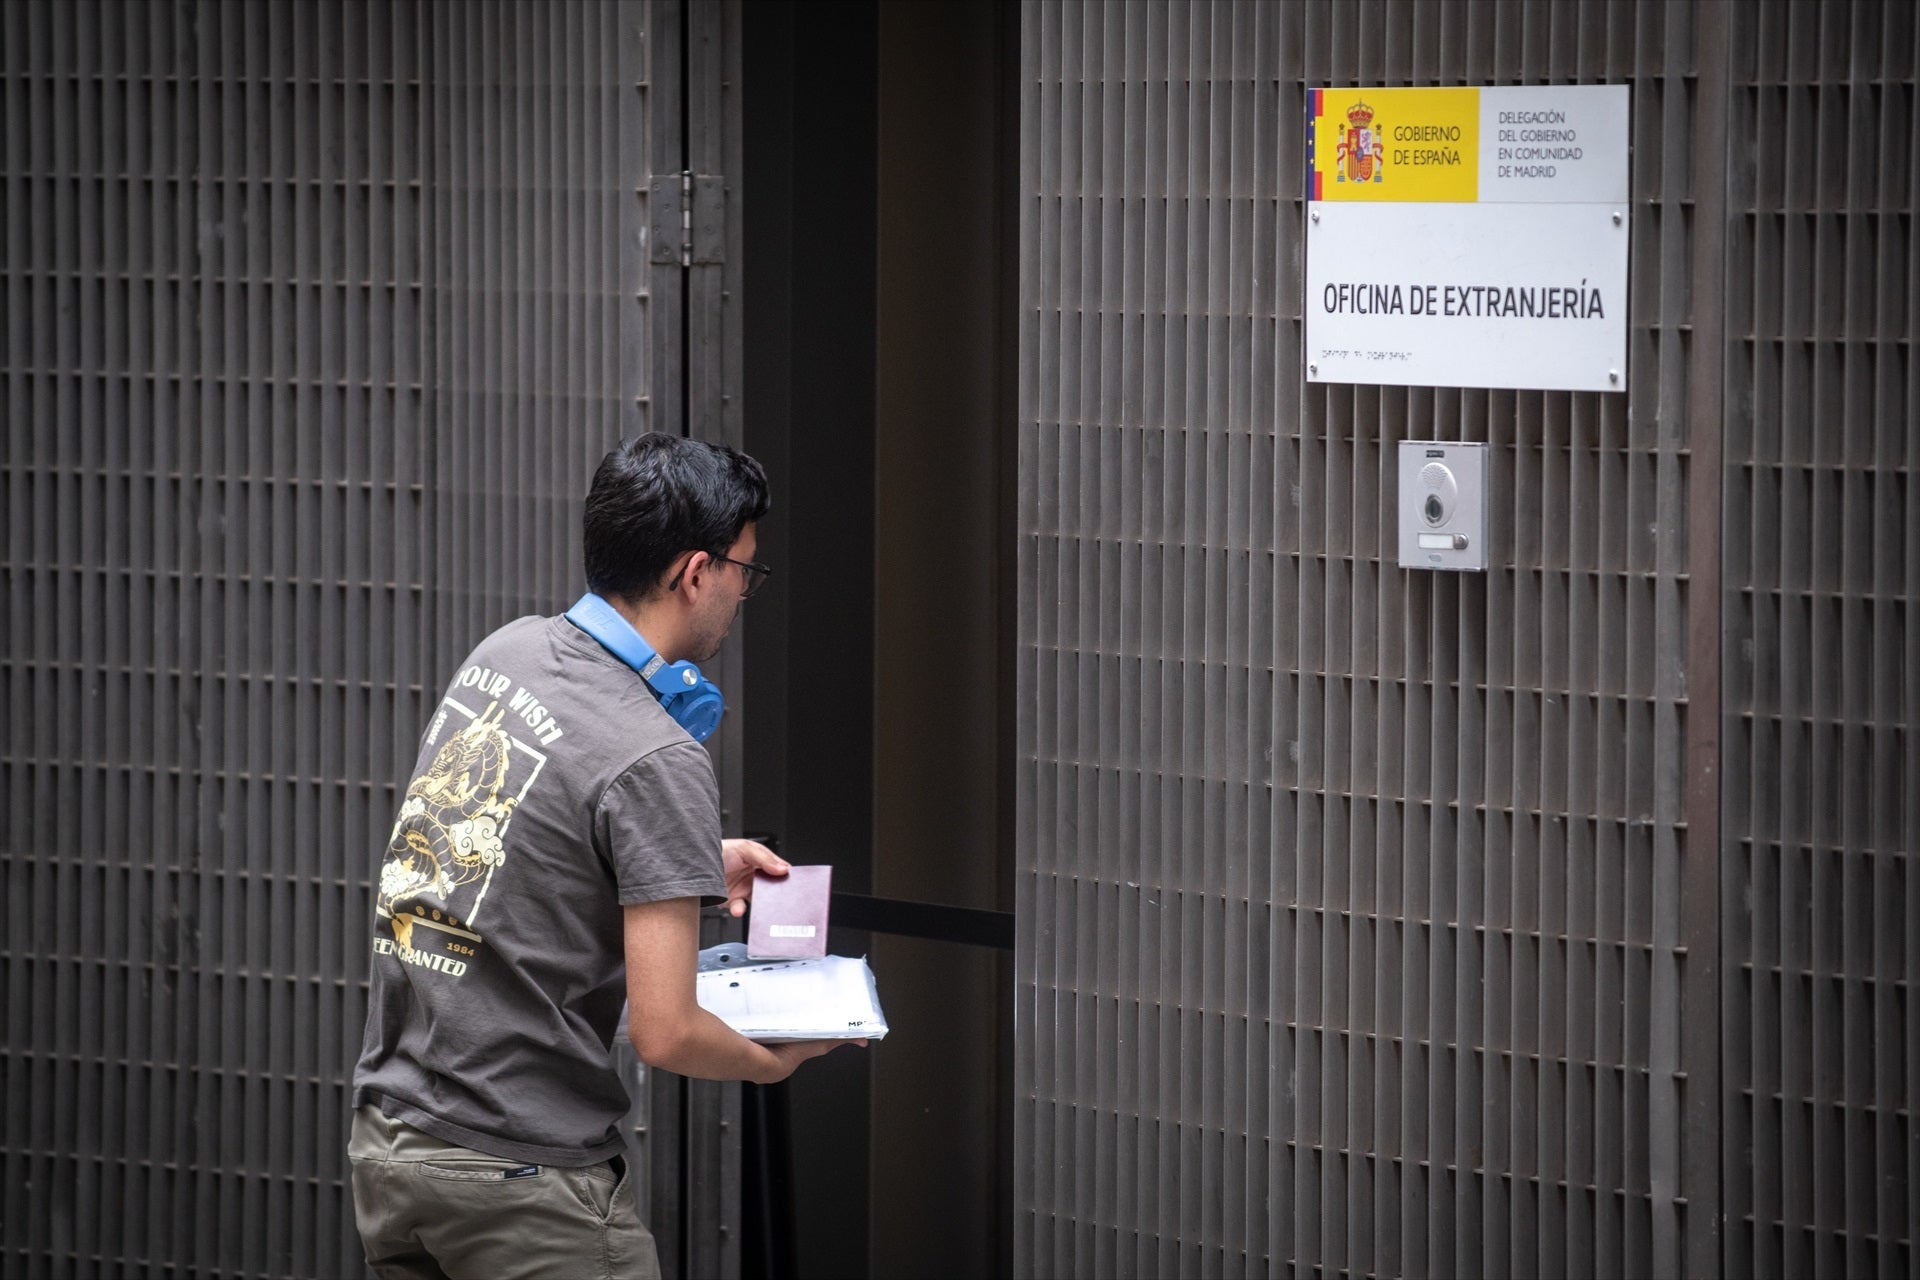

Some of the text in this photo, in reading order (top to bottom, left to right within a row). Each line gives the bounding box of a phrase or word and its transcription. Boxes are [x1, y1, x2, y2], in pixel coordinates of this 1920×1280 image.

[1499, 109, 1565, 124] DELEGACIÓN
[1394, 126, 1461, 141] GOBIERNO
[1498, 130, 1576, 142] DEL GOBIERNO
[1394, 147, 1461, 165] DE ESPAÑA
[1498, 148, 1583, 160] EN COMUNIDAD
[1498, 166, 1556, 178] DE MADRID
[1324, 278, 1605, 319] OFICINA DE EXTRANJERÍA
[508, 687, 563, 746] WISH
[446, 942, 475, 959] 1984
[398, 944, 467, 977] GRANTED
